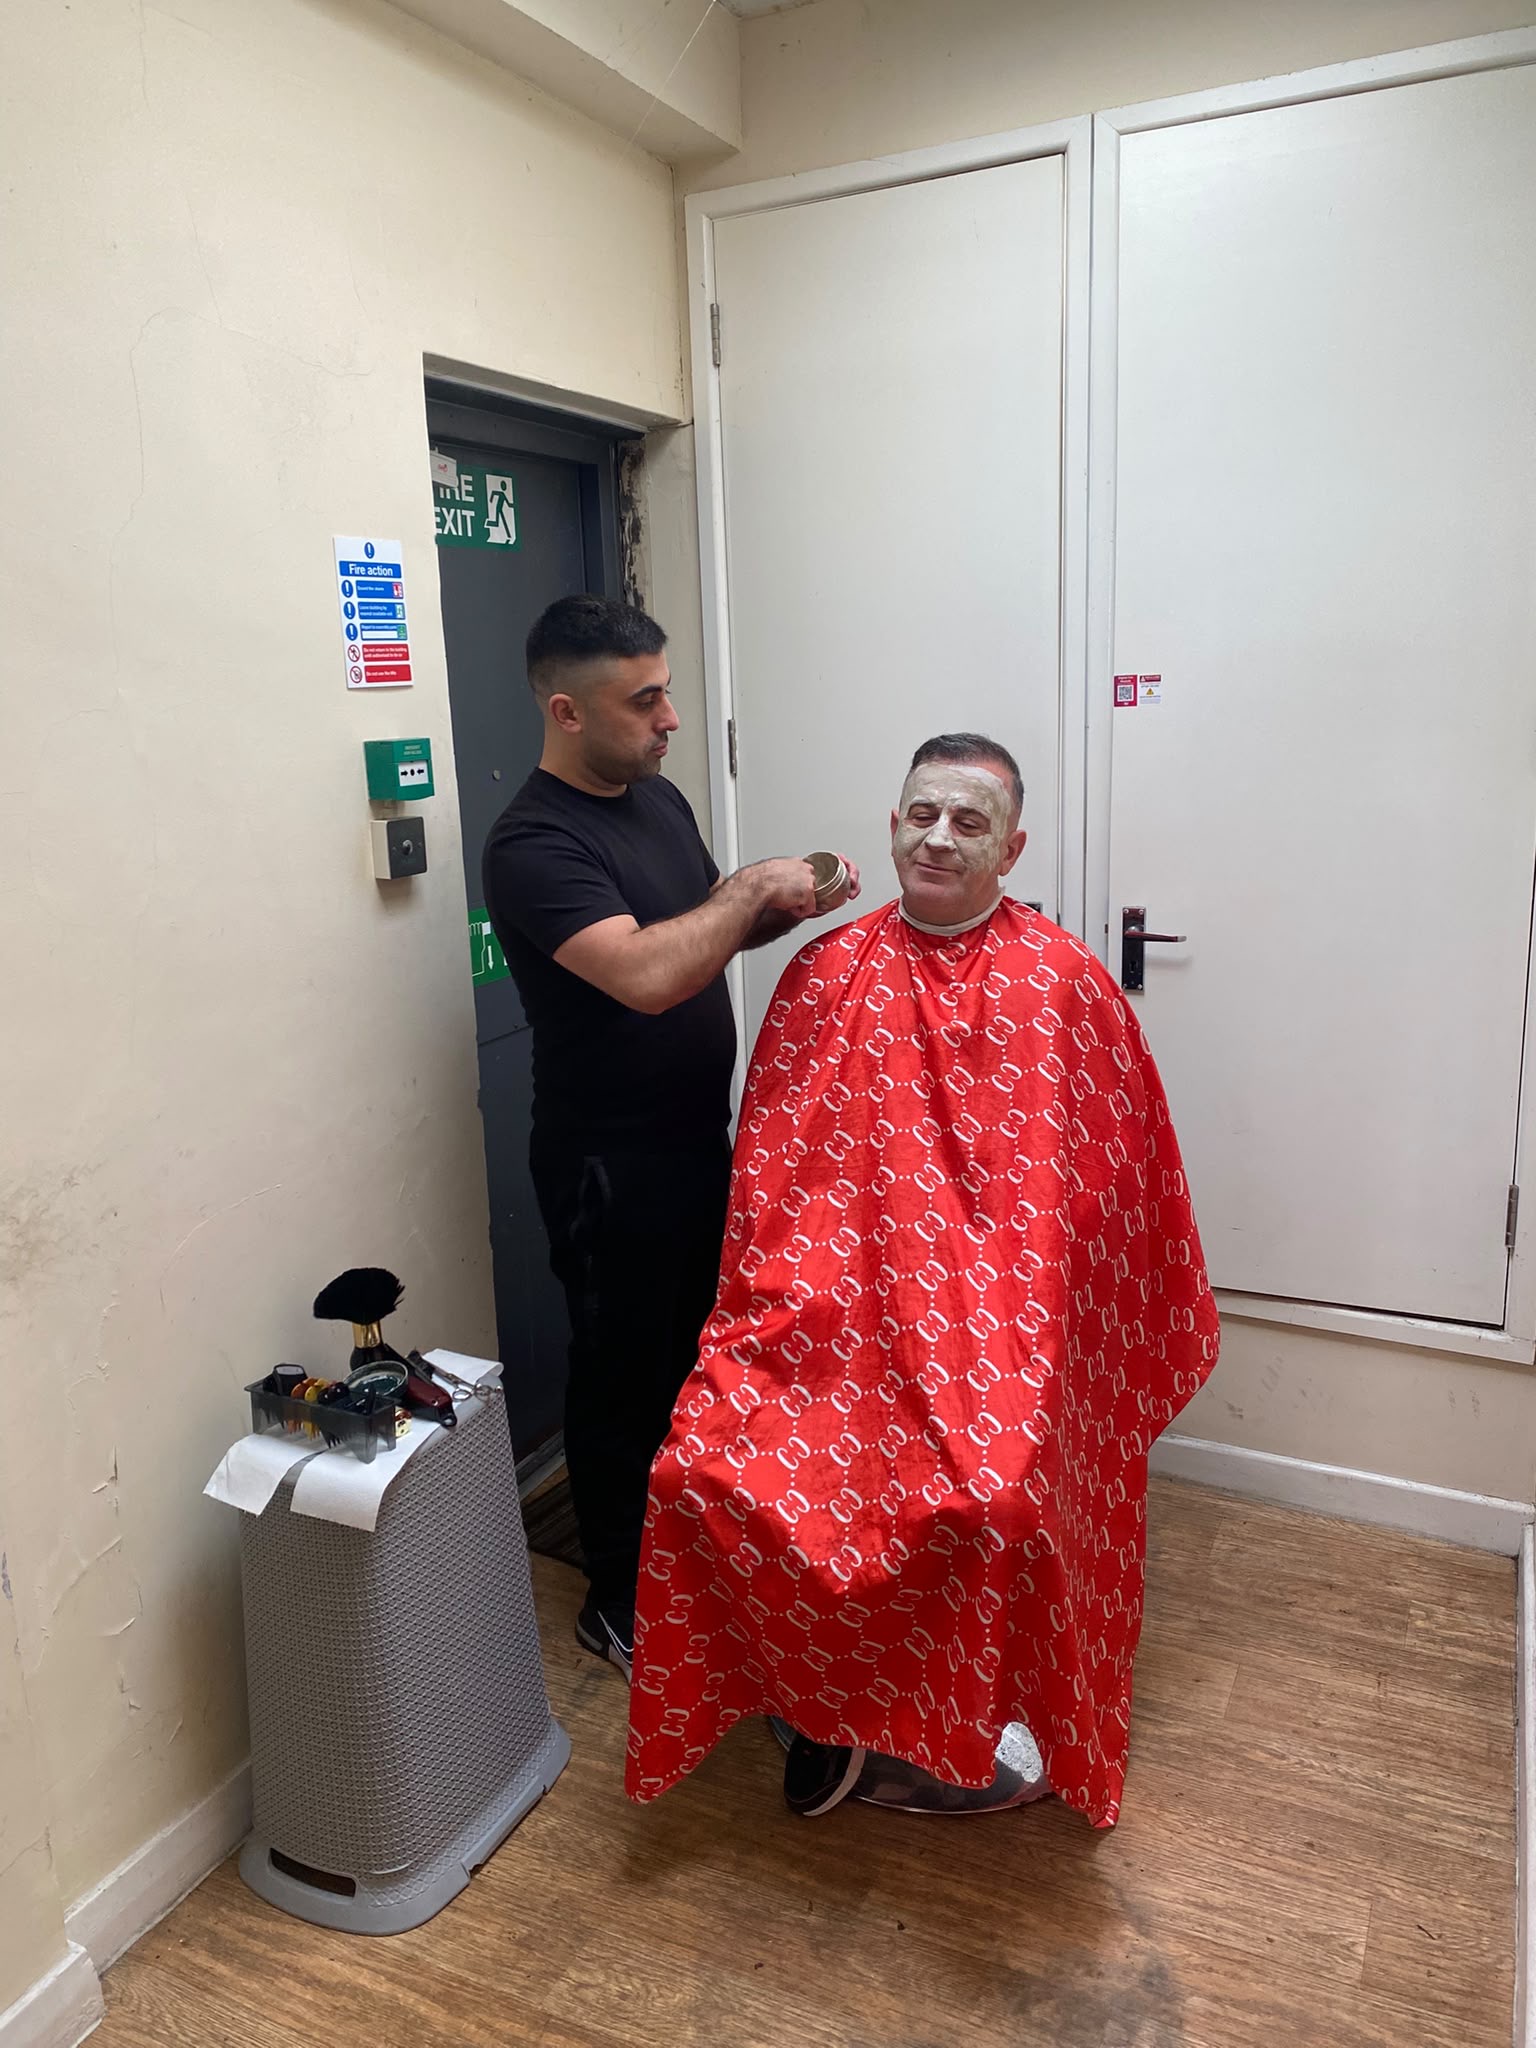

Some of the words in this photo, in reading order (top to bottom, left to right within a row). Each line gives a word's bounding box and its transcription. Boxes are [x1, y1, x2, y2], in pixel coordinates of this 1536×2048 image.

[434, 506, 475, 537] EXIT
[349, 563, 366, 575] Fire
[367, 565, 393, 576] action
